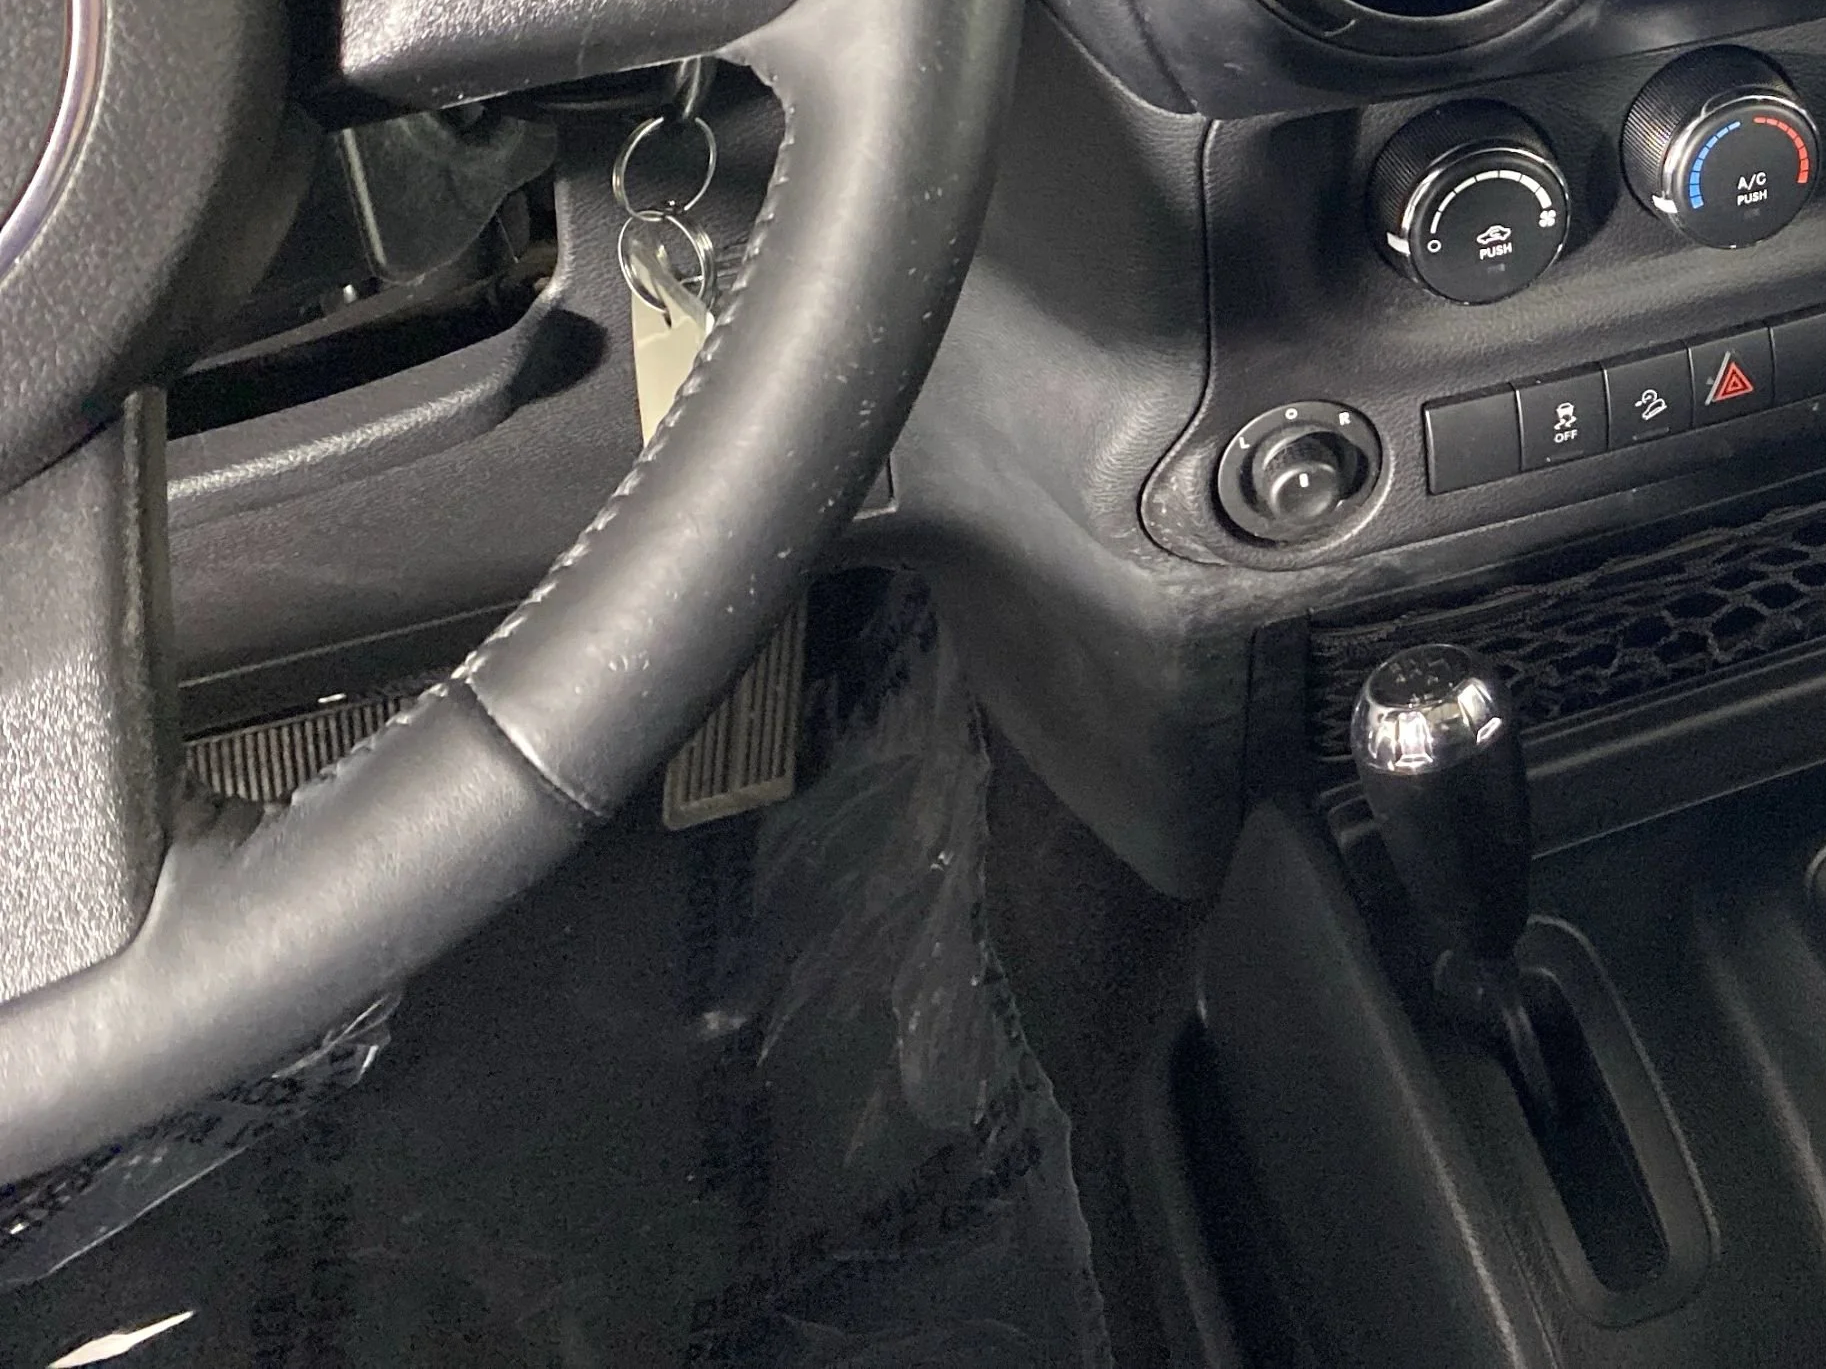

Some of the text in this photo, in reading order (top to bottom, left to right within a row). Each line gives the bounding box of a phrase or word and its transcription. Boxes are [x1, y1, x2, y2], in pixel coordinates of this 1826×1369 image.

[1737, 171, 1767, 190] A/C
[1737, 189, 1768, 206] PUSH
[1479, 242, 1513, 260] PUSH
[1554, 429, 1578, 443] OFF
